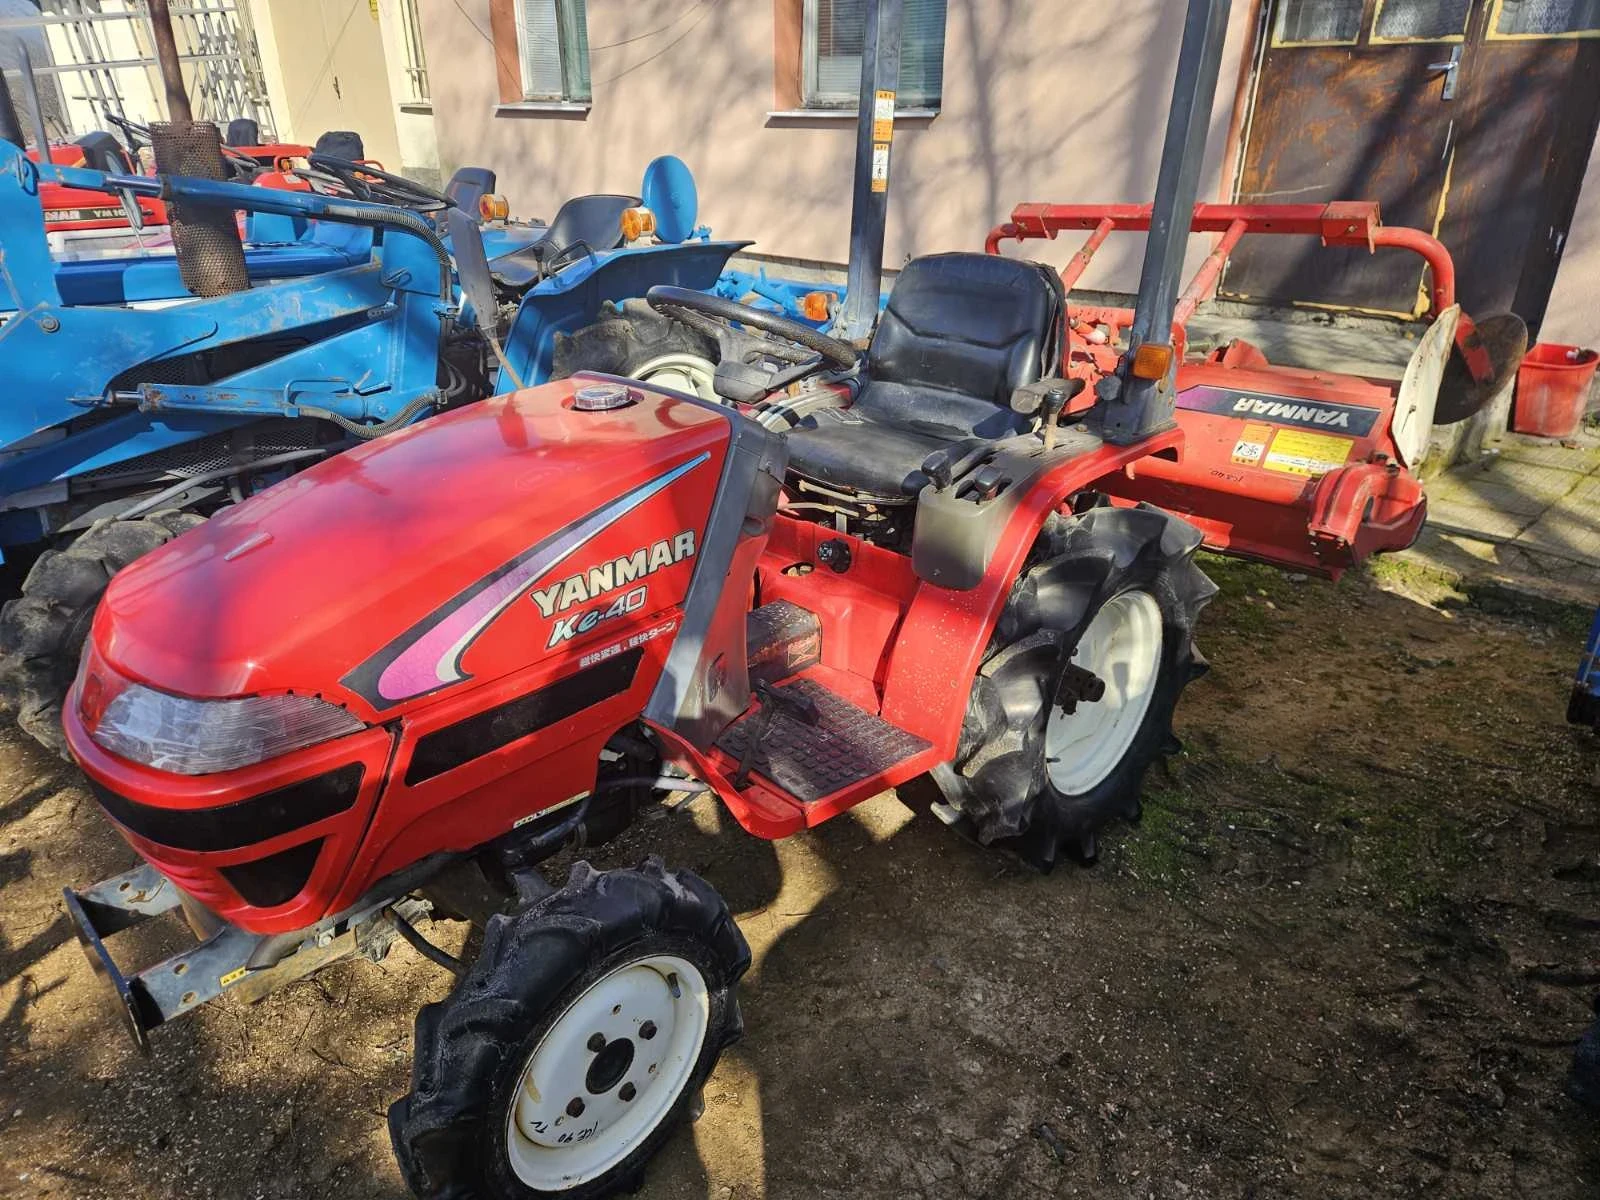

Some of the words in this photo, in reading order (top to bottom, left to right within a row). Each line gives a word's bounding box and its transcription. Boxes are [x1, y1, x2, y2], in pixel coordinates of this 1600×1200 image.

[1232, 397, 1350, 428] YANMAR
[531, 529, 696, 619] YANMAR
[546, 585, 648, 650] Ke-40
